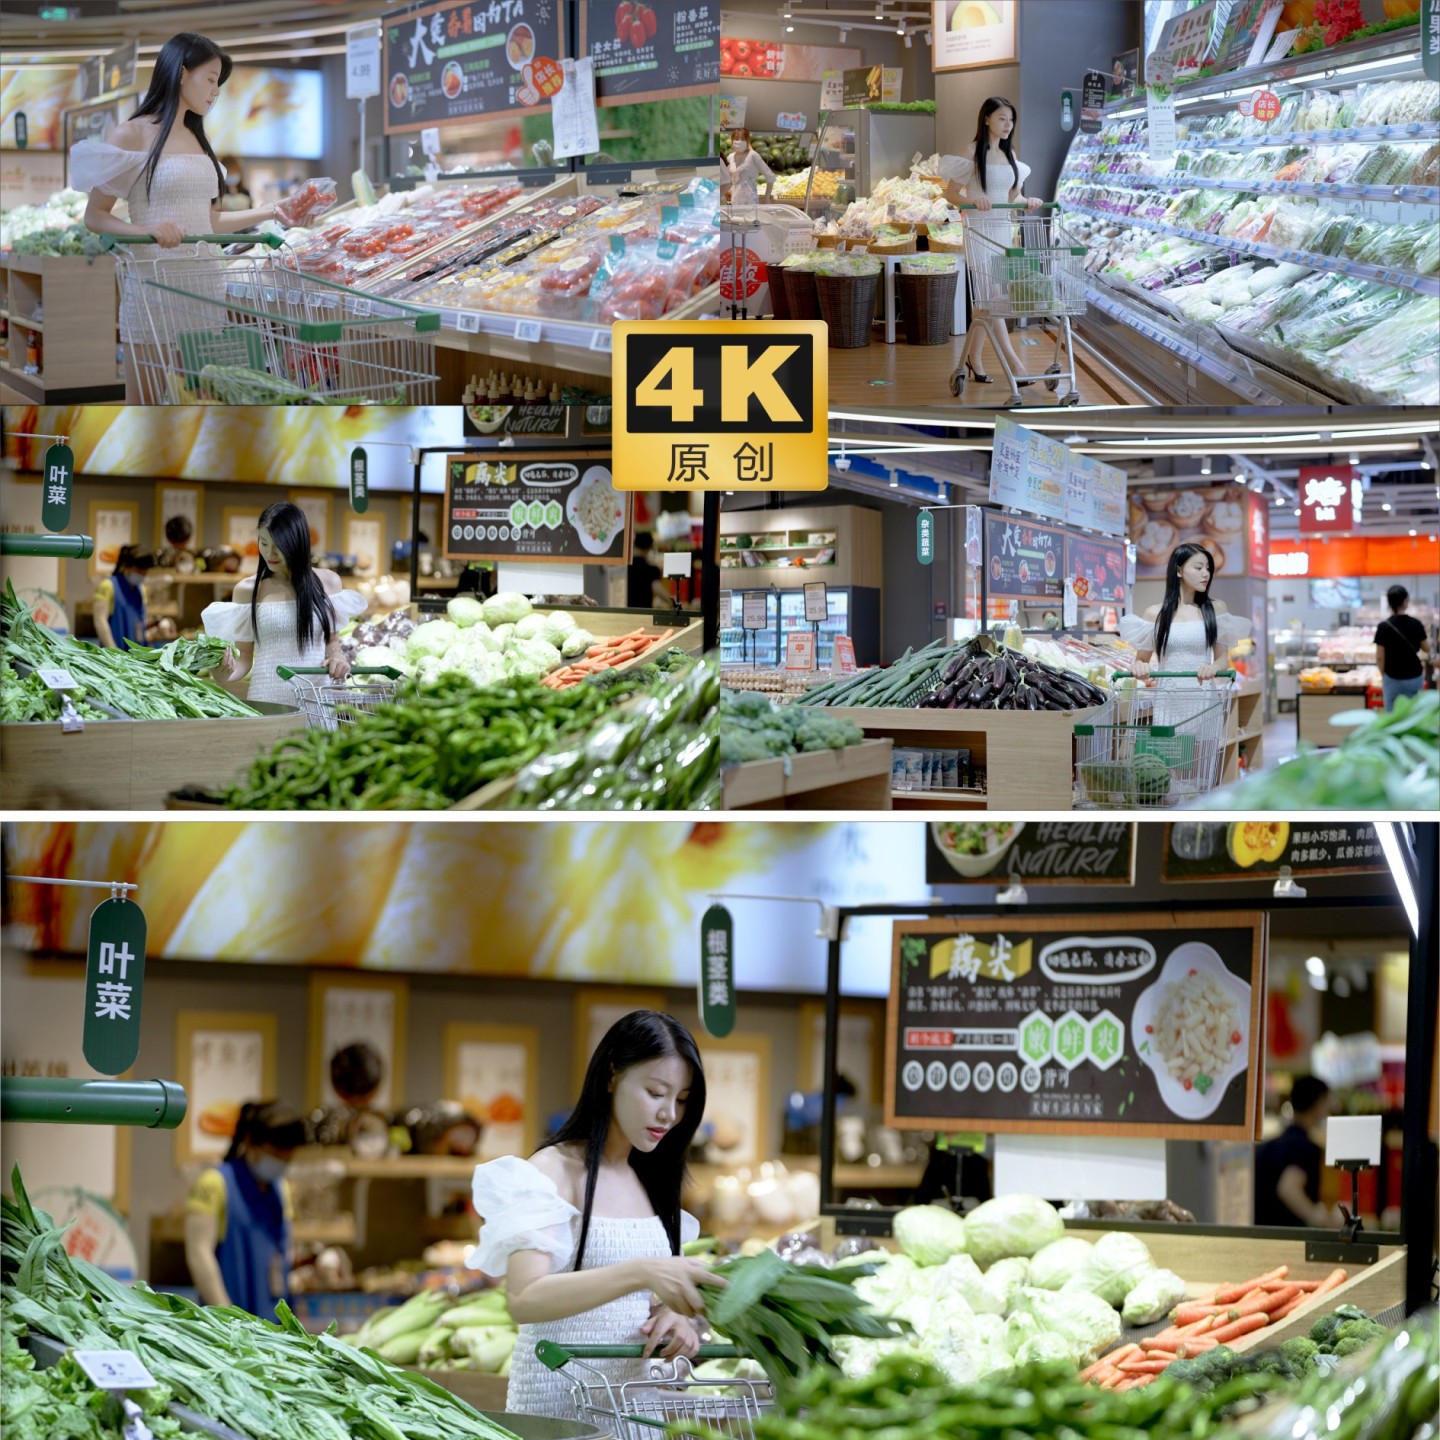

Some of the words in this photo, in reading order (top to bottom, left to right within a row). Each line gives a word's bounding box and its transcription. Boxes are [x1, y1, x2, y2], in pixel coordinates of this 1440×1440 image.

[1257, 100, 1276, 109] 店长
[1257, 109, 1275, 119] 推荐
[47, 465, 69, 505] 叶菜
[920, 519, 930, 557] 杂类蔬菜
[706, 928, 729, 1006] 根茎类
[948, 933, 1016, 984] 藕尖
[95, 942, 135, 1020] 叶菜
